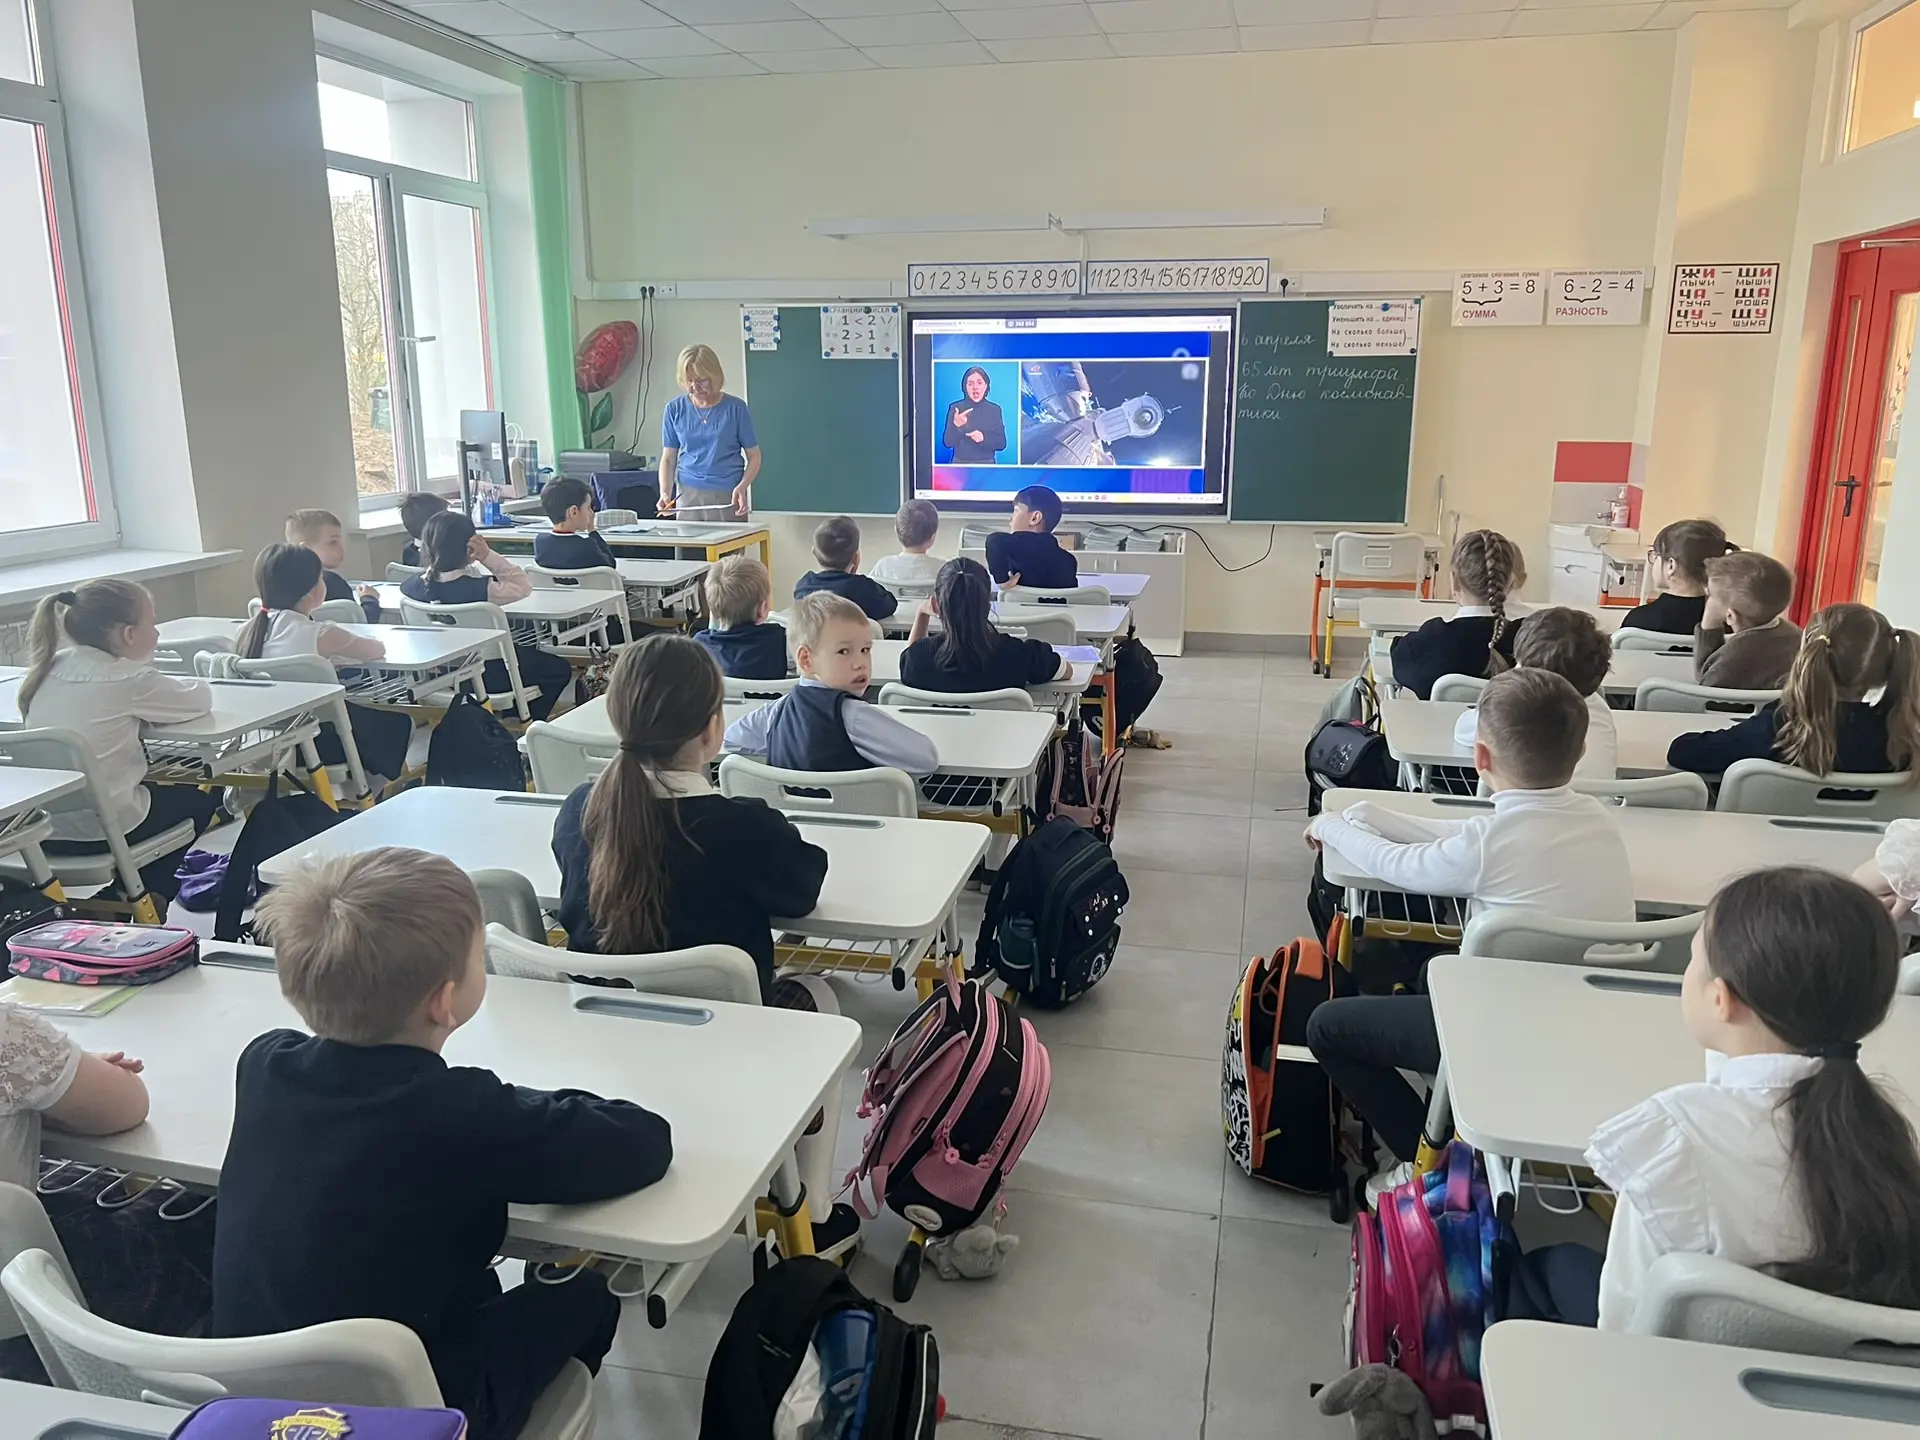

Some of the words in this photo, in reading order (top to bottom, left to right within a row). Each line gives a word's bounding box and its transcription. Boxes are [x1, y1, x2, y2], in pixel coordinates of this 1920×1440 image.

[1090, 268, 1103, 288] 11
[1105, 268, 1121, 288] 12
[1123, 268, 1137, 287] 13
[1140, 268, 1155, 287] 14
[1158, 267, 1174, 287] 15
[1175, 267, 1191, 287] 16
[1193, 267, 1210, 286] 17
[1211, 266, 1227, 286] 18
[1227, 266, 1244, 286] 19
[1243, 266, 1264, 286] 20
[1681, 268, 1715, 278] ЖИ
[1738, 267, 1772, 278] ШИ
[914, 272, 924, 290] 0
[929, 272, 937, 290] 1
[939, 271, 951, 290] 2
[956, 271, 966, 289] 3
[971, 271, 981, 289] 4
[987, 270, 998, 289] 5
[1002, 270, 1013, 289] 6
[1017, 270, 1028, 288] 7
[1031, 269, 1042, 288] 8
[1047, 269, 1057, 288] 9
[1061, 268, 1077, 288] 10
[1462, 280, 1472, 295] 5
[1478, 282, 1488, 293] +
[1493, 280, 1504, 295] 3
[1509, 283, 1520, 291] =
[1525, 279, 1536, 294] 8
[1564, 278, 1574, 294] 6
[1591, 278, 1602, 293] 2
[1608, 281, 1619, 290] =
[1624, 278, 1635, 292] 4
[1680, 289, 1706, 299] ЧА
[1734, 288, 1770, 299] ЩА
[1462, 310, 1497, 319] СУММА
[1556, 307, 1608, 316] РАЗНОСТЬ
[1676, 309, 1703, 320] ЧУ
[842, 315, 850, 326] 1
[867, 315, 876, 326] 2
[842, 329, 850, 340] 2
[868, 329, 876, 340] 1
[842, 343, 850, 354] 1
[868, 343, 876, 354] 1
[1254, 333, 1316, 353] апреля
[1242, 361, 1262, 377] 65
[1264, 364, 1292, 377] лет
[1266, 382, 1307, 400] Дню
